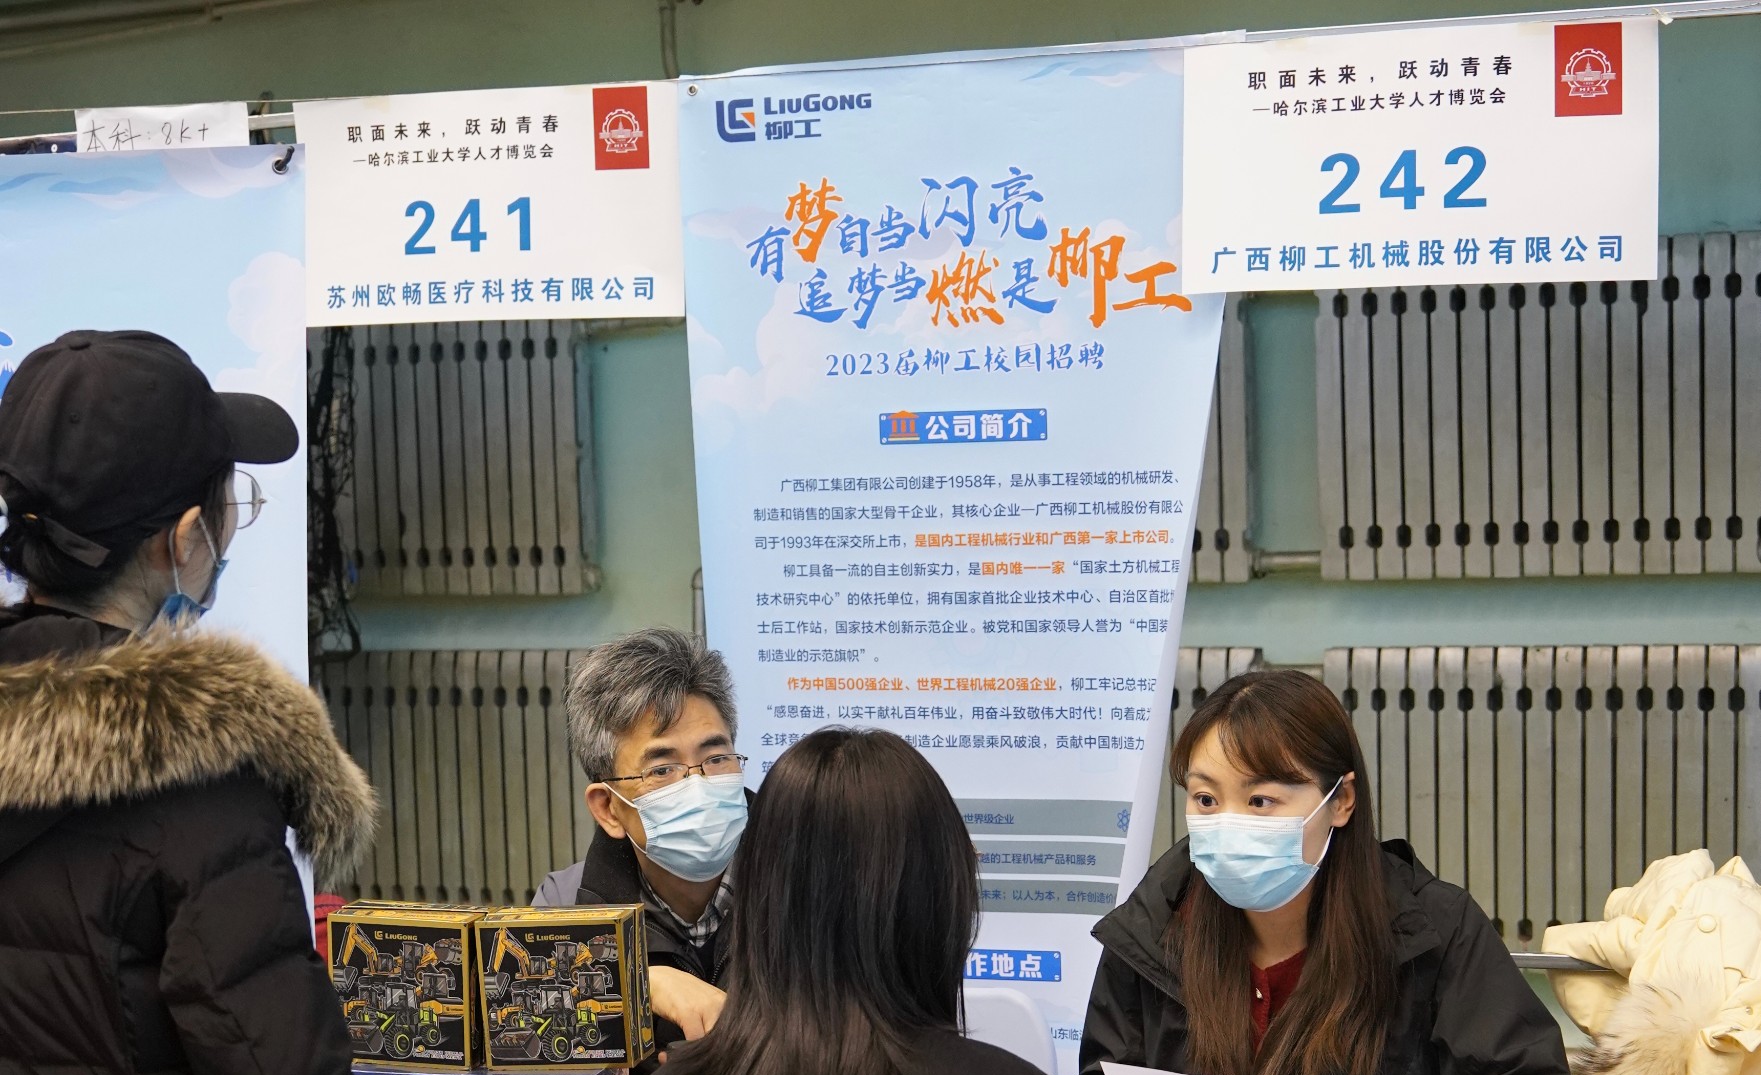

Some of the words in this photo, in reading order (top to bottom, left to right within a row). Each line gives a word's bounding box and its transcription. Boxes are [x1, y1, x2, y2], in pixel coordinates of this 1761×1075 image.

[1248, 54, 1512, 91] 职面未来，跃动青春
[347, 114, 559, 143] 职面未来，跃动青春
[765, 118, 822, 140] 柳工
[1318, 145, 1488, 215] 242
[403, 196, 532, 255] 241
[746, 166, 1049, 282] 有梦自当闪亮
[1211, 235, 1624, 275] 广西柳工机械股份有限公司
[326, 276, 655, 310] 苏州欧畅医疗科技有限公司
[826, 341, 1104, 377] 2023届柳工校园招聘
[925, 411, 1033, 440] 公司简介
[780, 470, 1179, 493] 广西柳工集团有限公司创建于1958年，是从事工程领域的机械研发、
